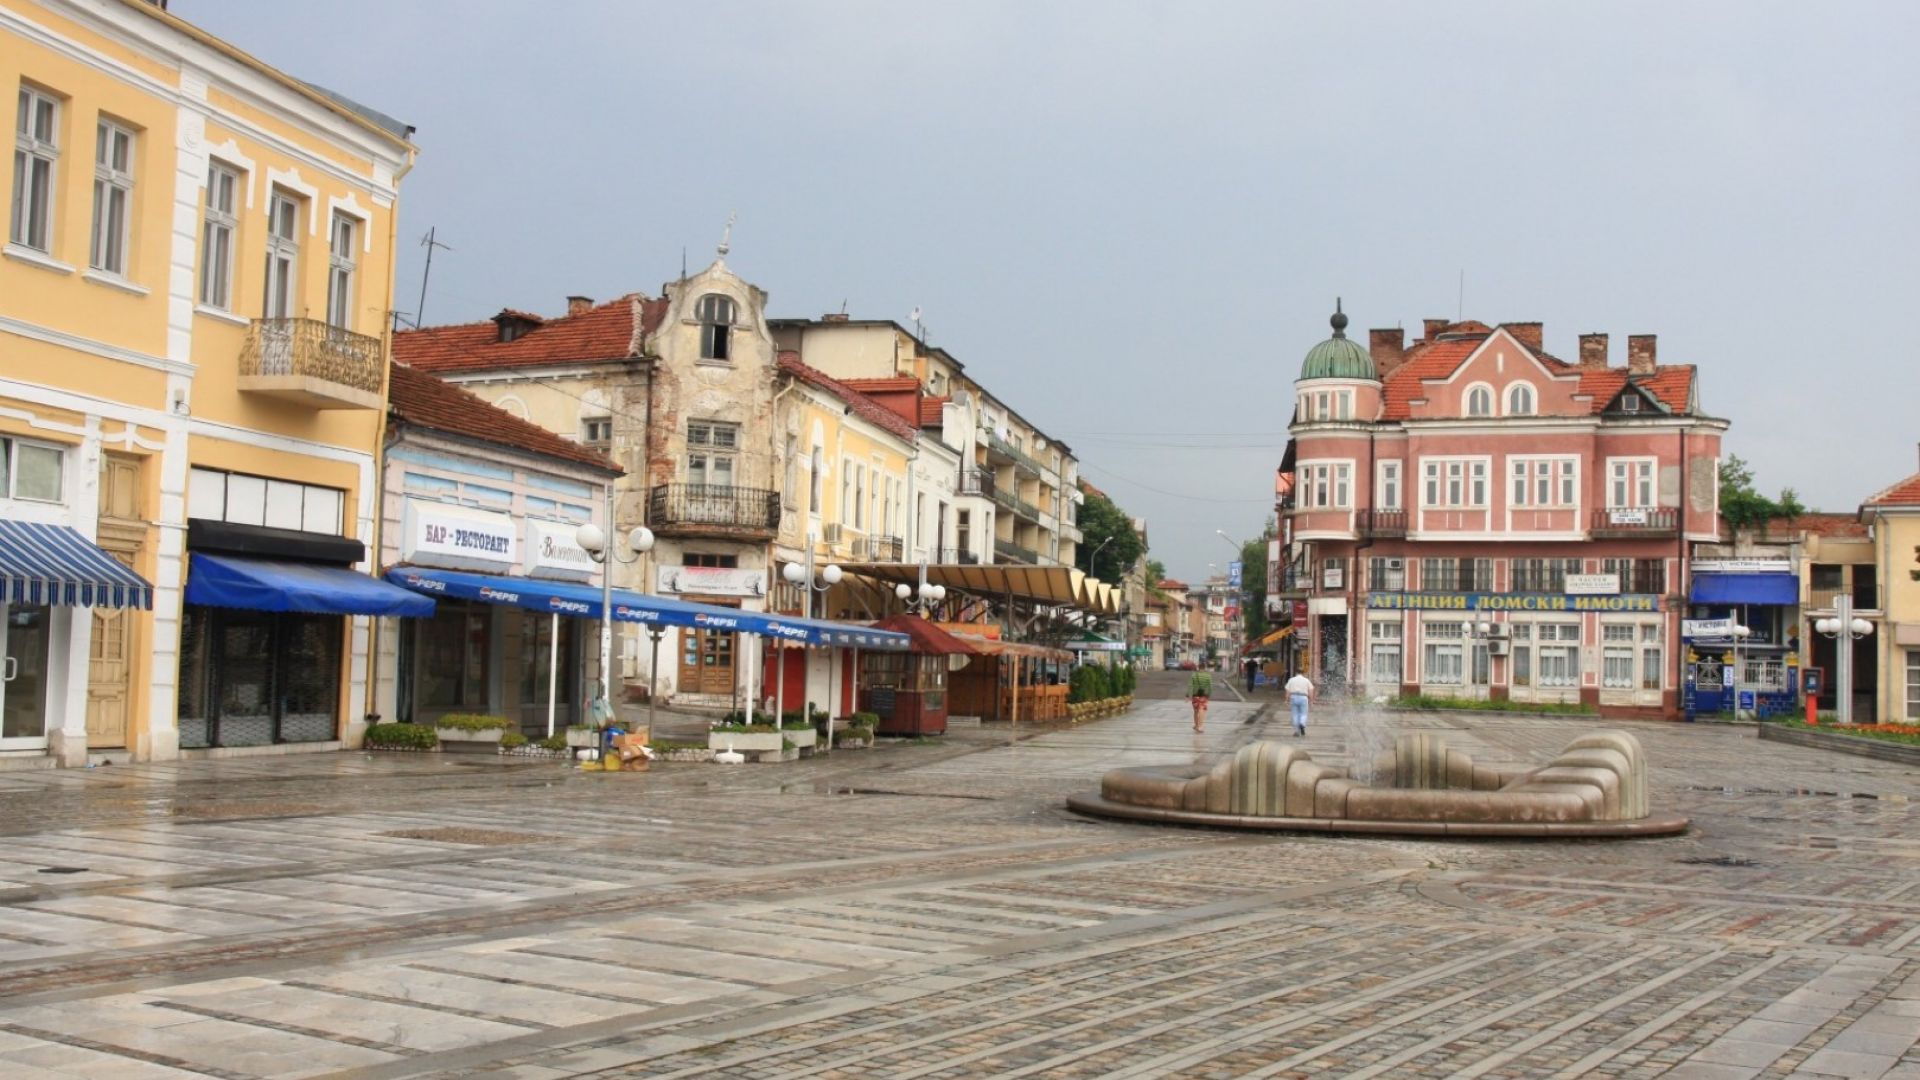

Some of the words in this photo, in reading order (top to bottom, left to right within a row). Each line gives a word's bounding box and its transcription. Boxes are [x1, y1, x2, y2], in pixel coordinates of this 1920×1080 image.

[425, 524, 447, 544] БАР
[455, 529, 510, 554] РЕСТОРАНТ
[417, 578, 446, 592] PEPSI
[489, 589, 518, 603] PEPSI
[1373, 594, 1466, 609] АГЕНЦИЯ
[1575, 596, 1652, 610] ИМОТИ
[559, 600, 589, 613] PEPSI
[627, 608, 660, 621] PEPSI
[706, 617, 738, 628] PEPSI
[777, 626, 808, 639] PEPSI
